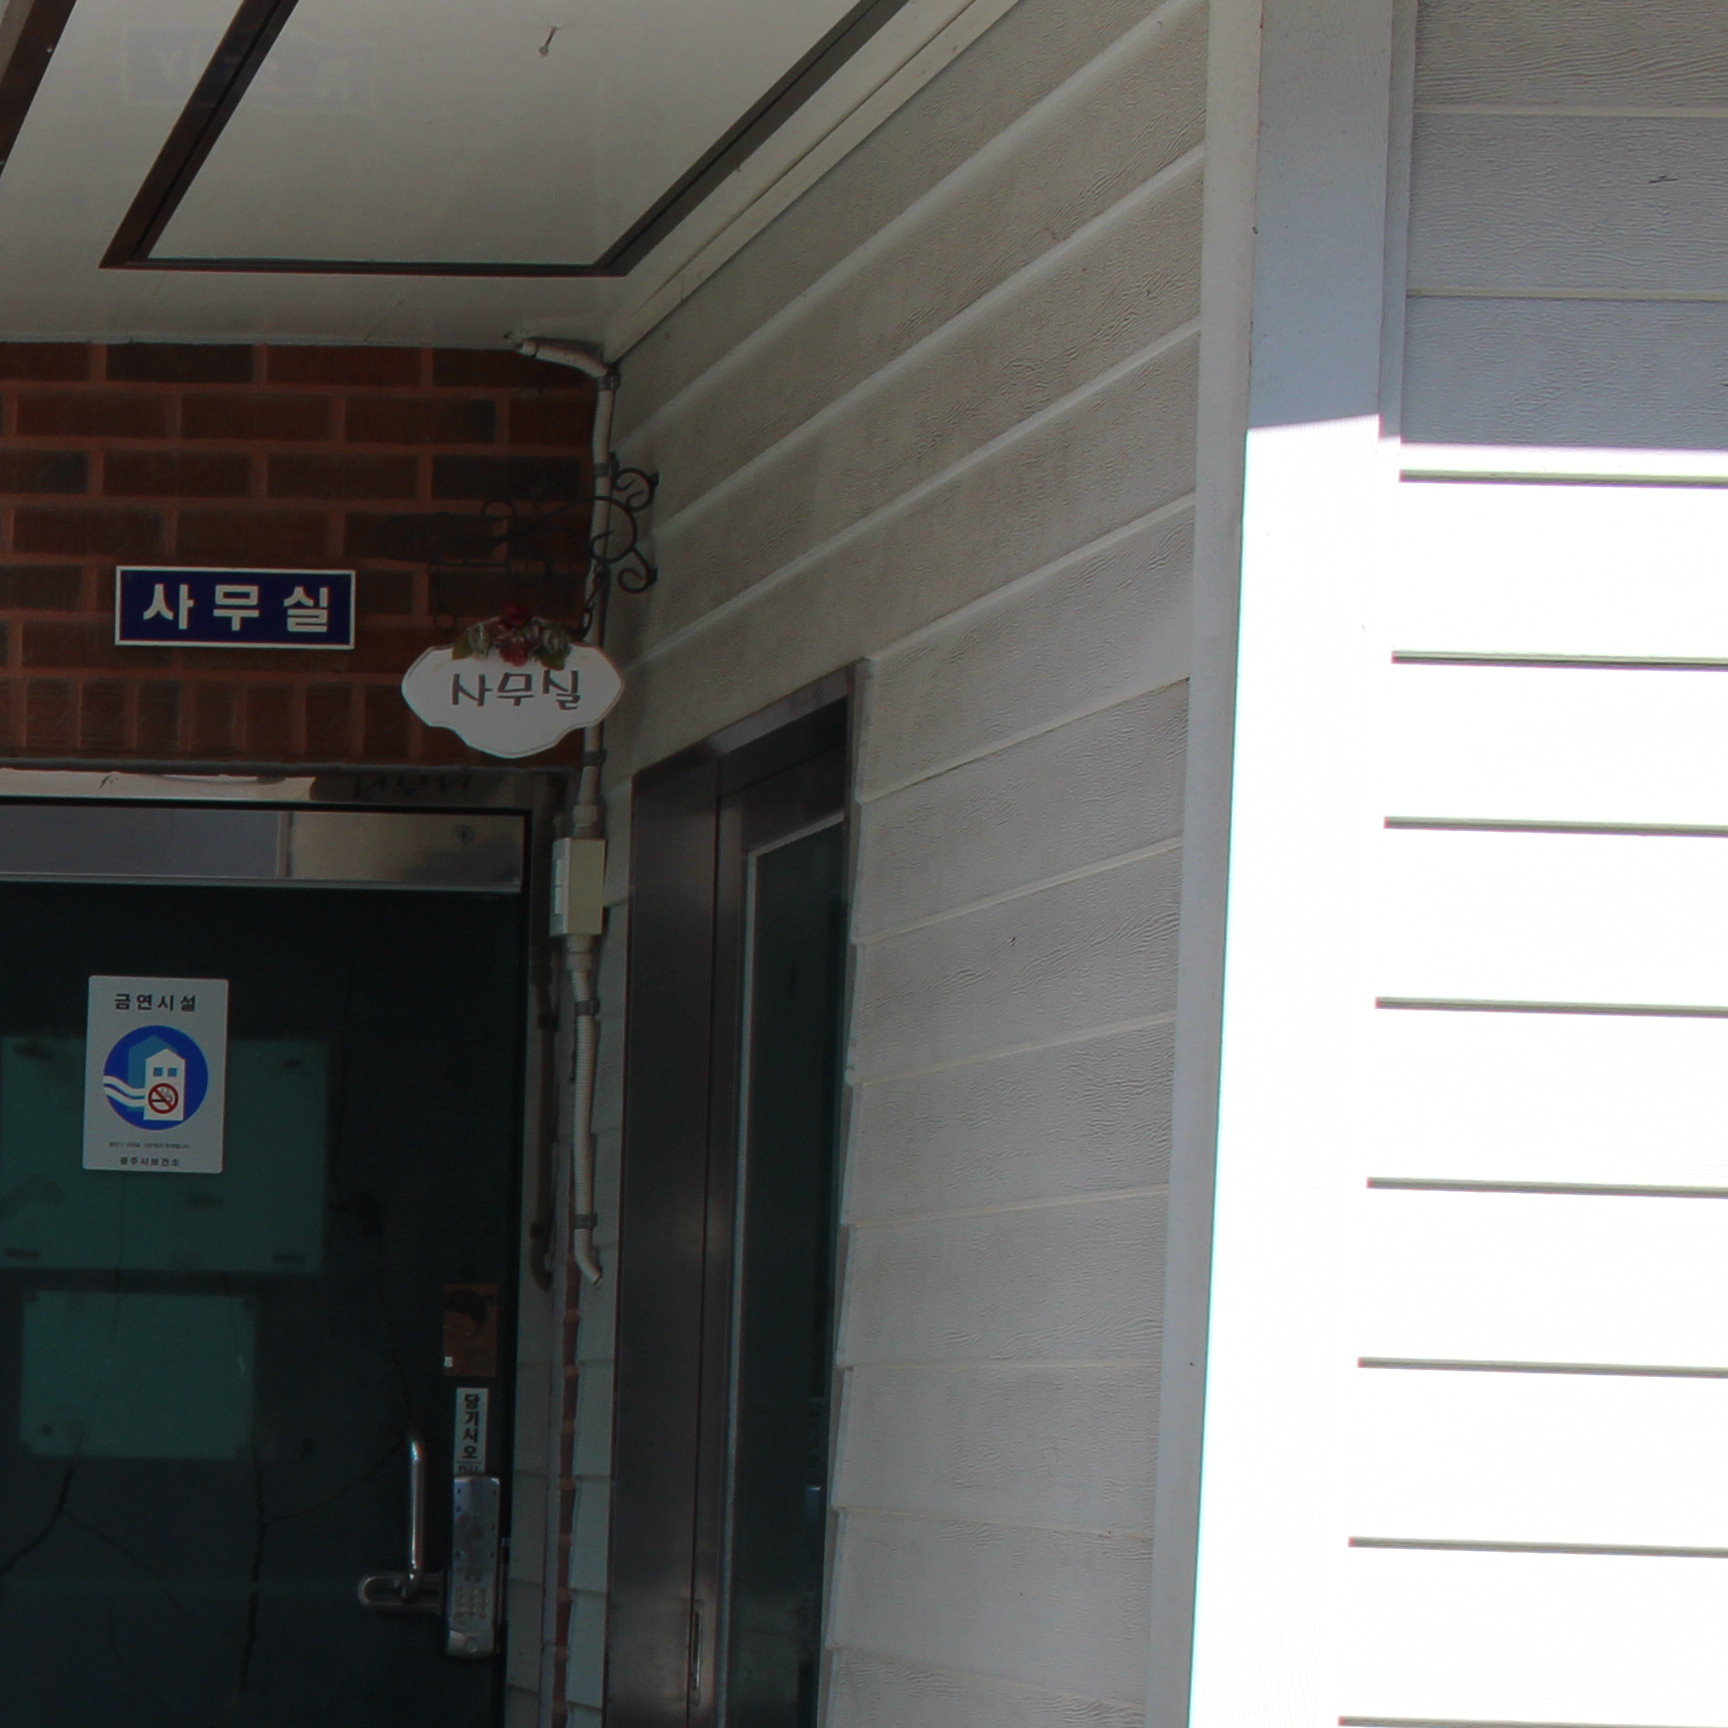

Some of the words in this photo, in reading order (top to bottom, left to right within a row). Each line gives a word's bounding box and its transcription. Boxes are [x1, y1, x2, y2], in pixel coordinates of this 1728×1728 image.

[142, 582, 331, 635] 사무실
[450, 668, 582, 711] 사무실
[114, 991, 198, 1013] 금연시설
[461, 1393, 481, 1460] 당기시오
